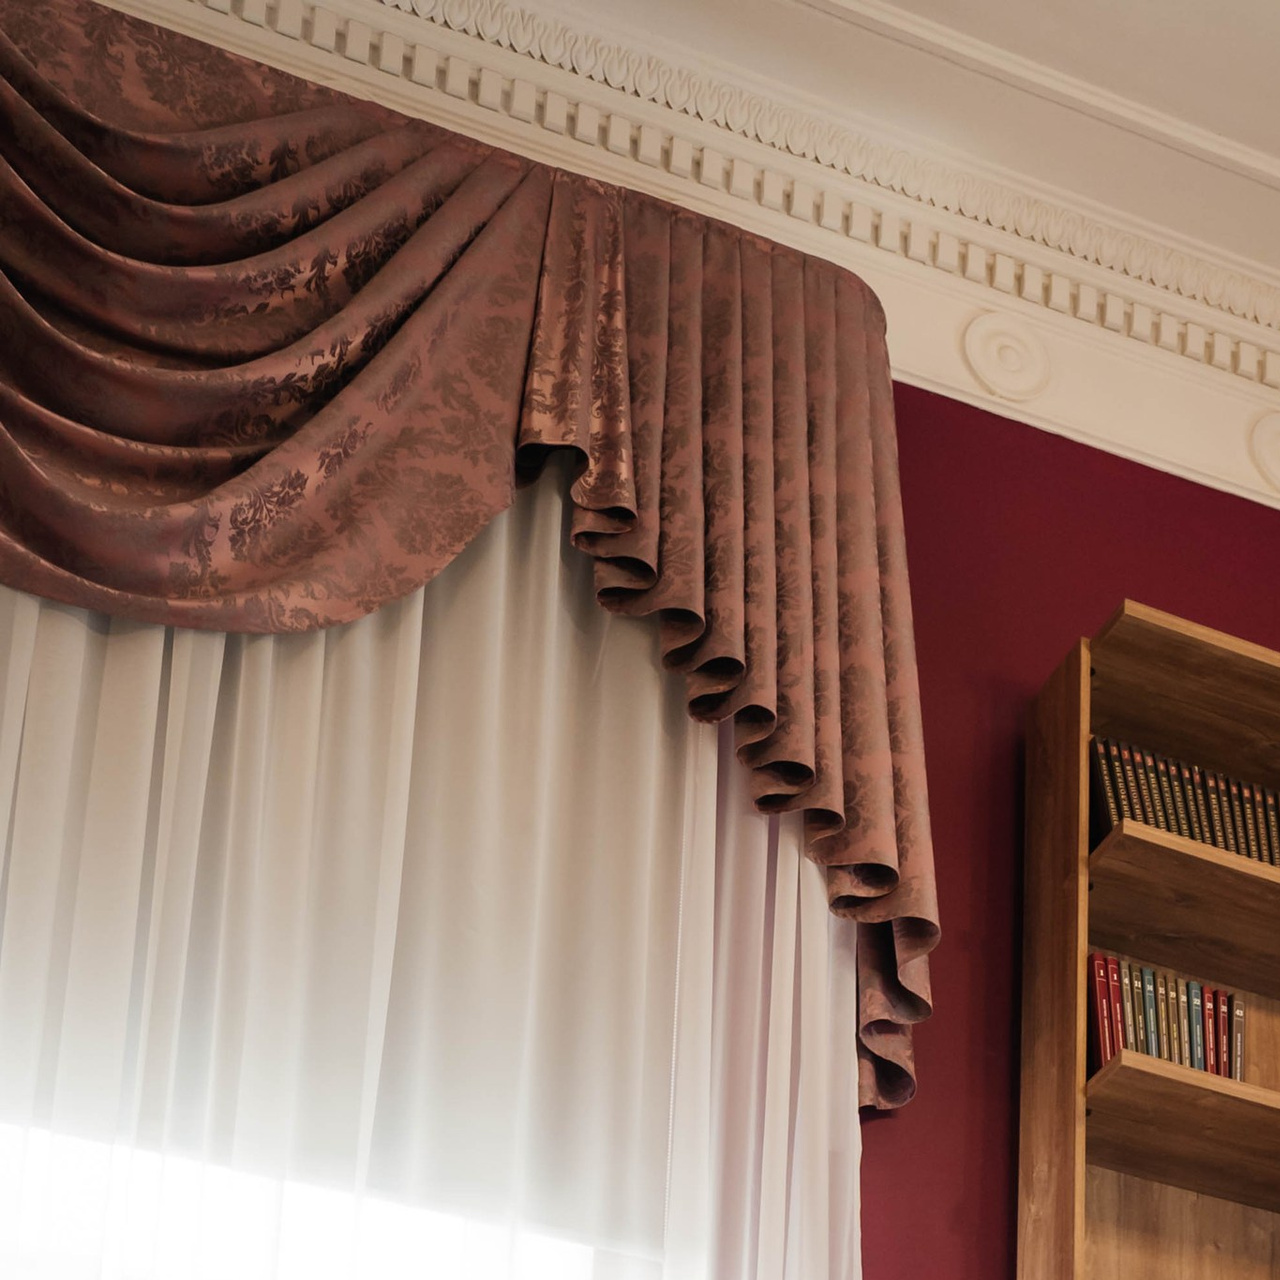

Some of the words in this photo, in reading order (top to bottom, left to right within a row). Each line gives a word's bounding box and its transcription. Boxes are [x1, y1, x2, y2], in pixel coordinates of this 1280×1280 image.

[1115, 761, 1131, 818] ЦИКЛОПЕДИЯ
[1126, 766, 1143, 824] ЦИКЛОПЕДИЯ
[1138, 768, 1156, 828] ЦИКЛОПЕДИЯ
[1150, 773, 1166, 832] ЦИКЛОПЕДИЯ
